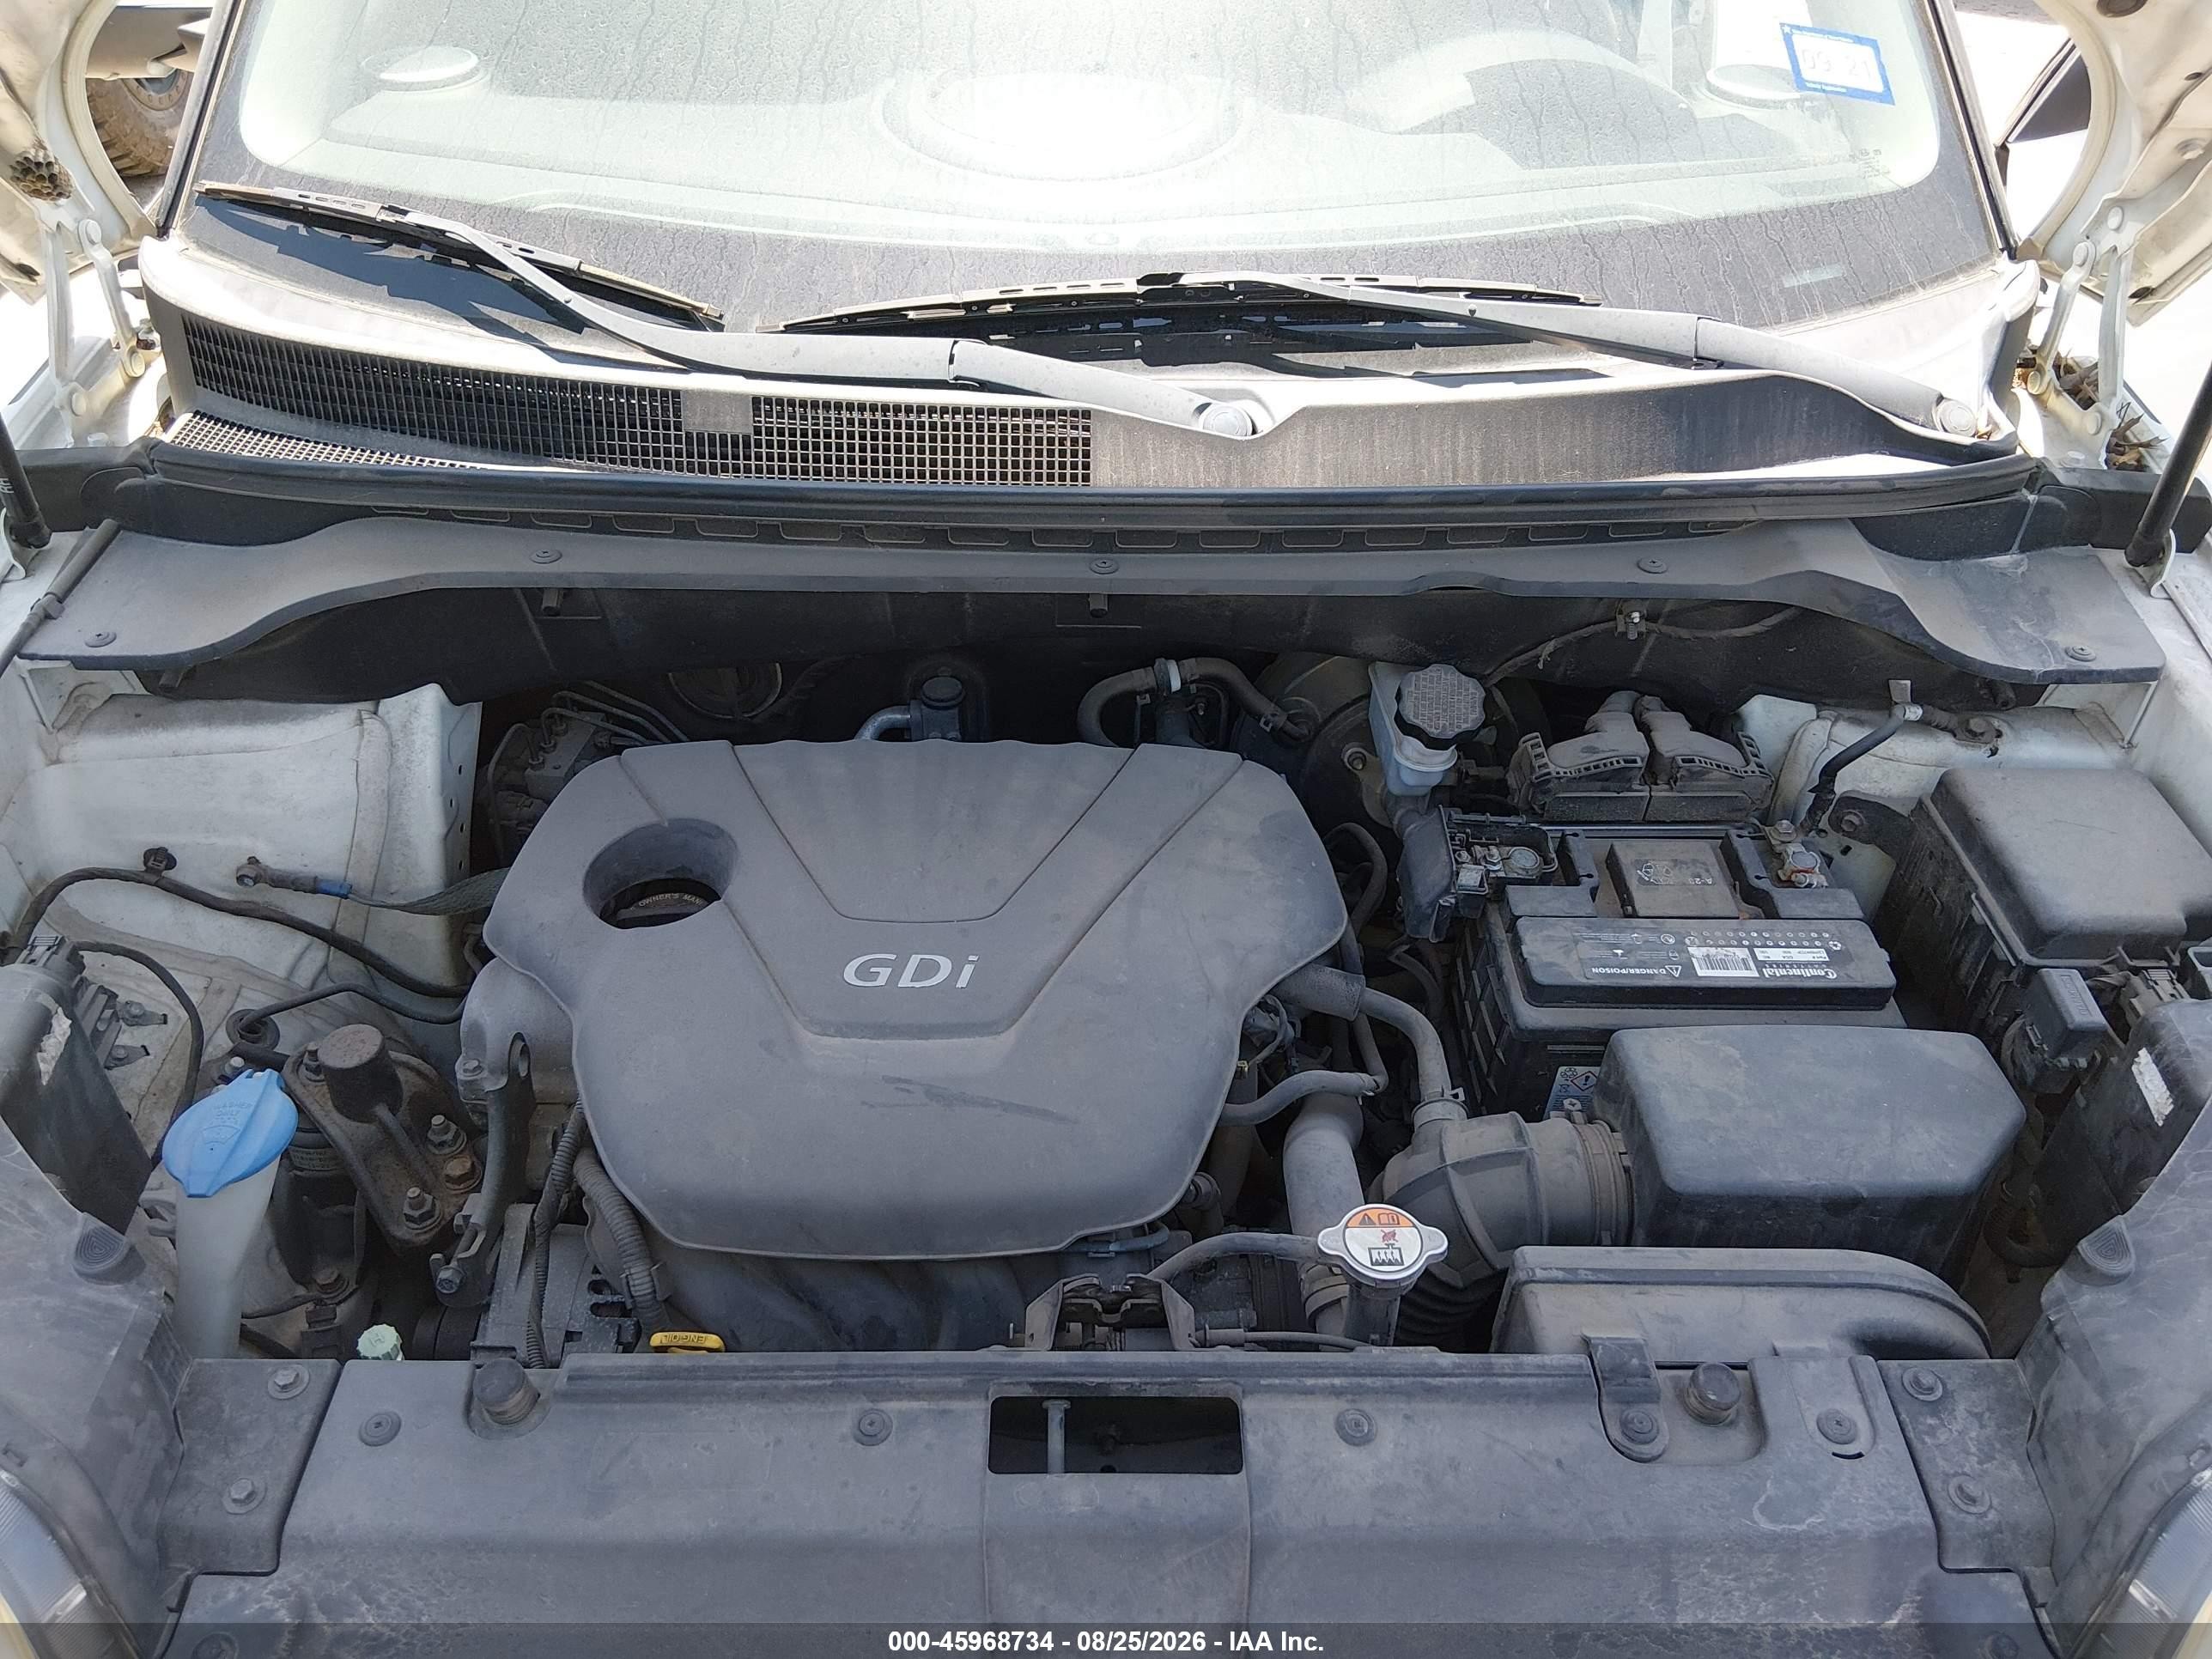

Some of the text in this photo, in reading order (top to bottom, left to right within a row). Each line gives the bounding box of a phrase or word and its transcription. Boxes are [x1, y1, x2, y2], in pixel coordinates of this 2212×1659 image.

[638, 892, 679, 907] OWNER'S
[842, 953, 980, 988] GDi
[1763, 968, 1838, 979] Continental
